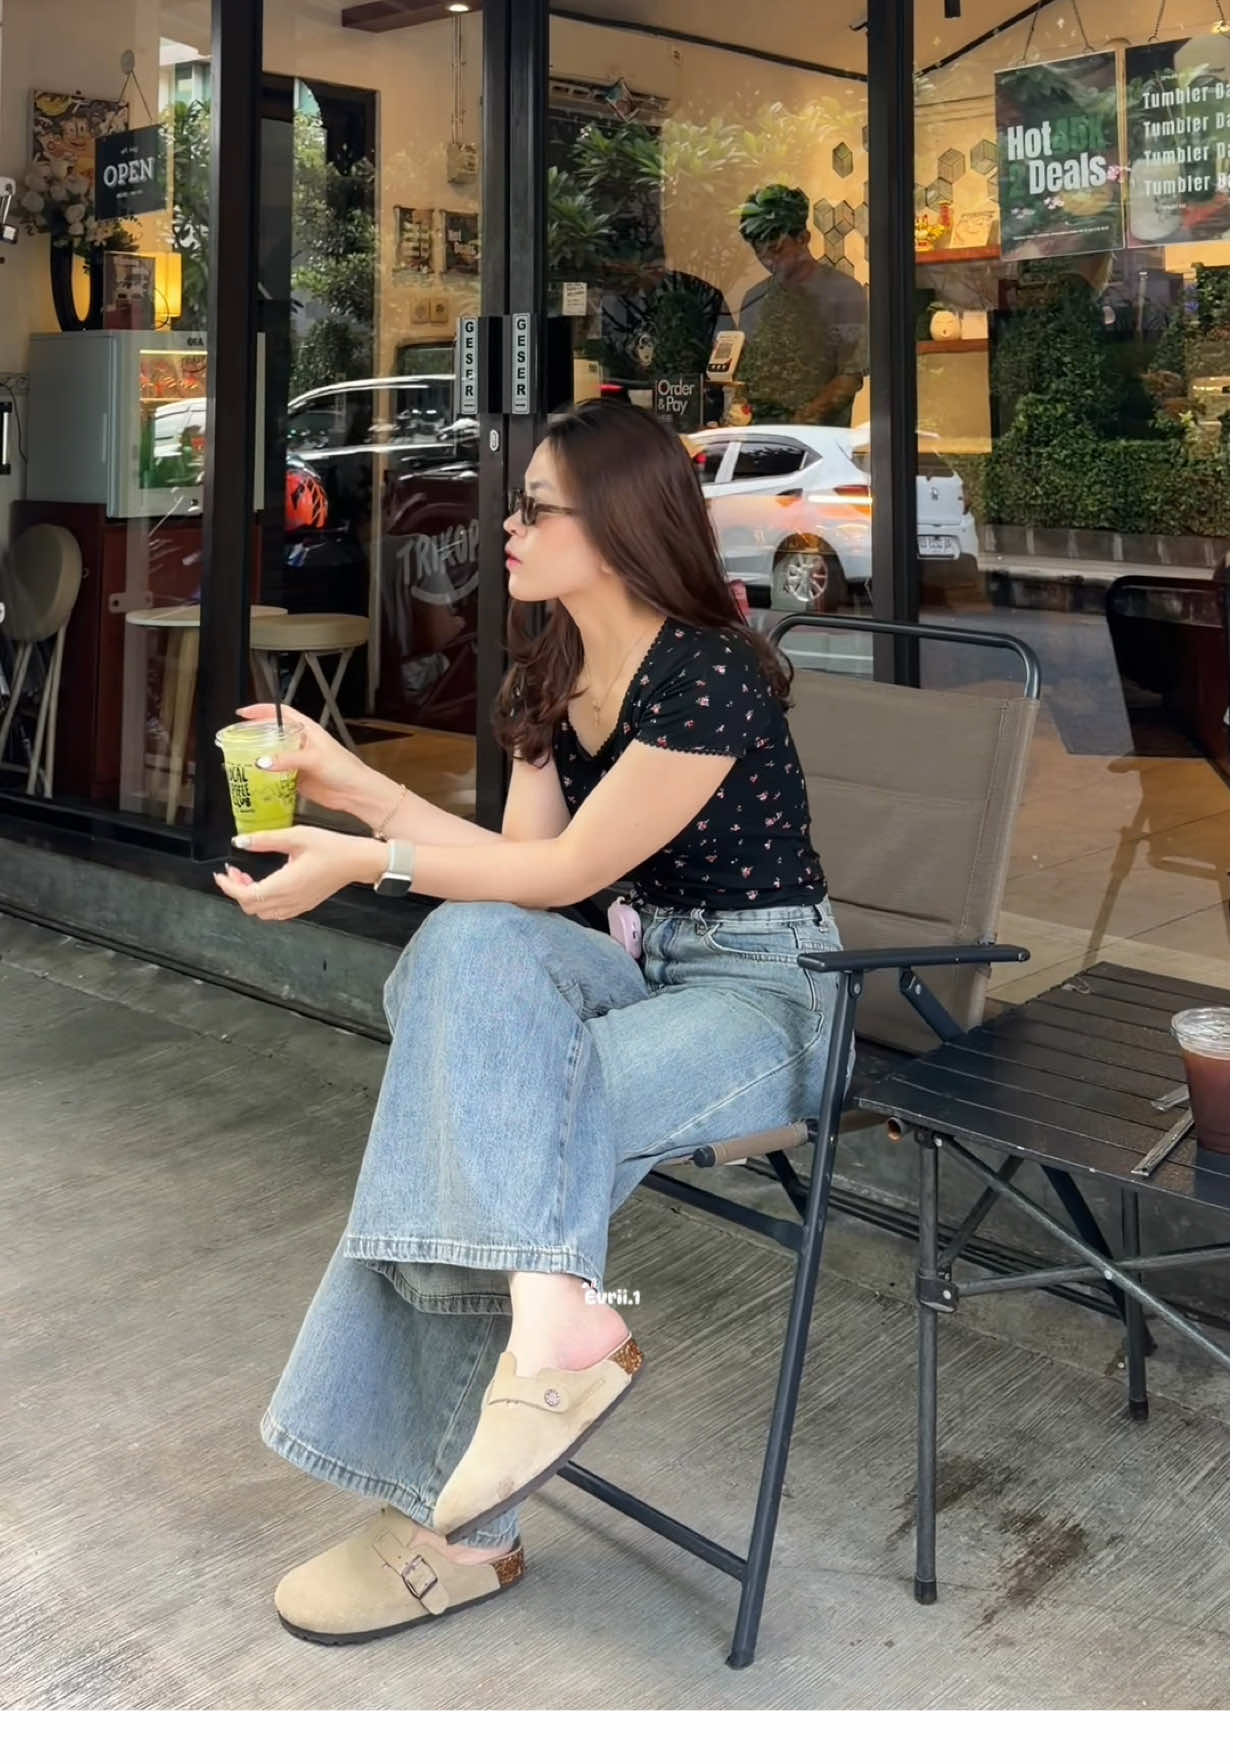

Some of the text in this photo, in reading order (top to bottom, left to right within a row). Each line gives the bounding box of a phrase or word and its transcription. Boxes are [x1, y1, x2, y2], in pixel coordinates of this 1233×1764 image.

[1142, 86, 1208, 109] Tumbler
[1143, 116, 1208, 139] Tumbler
[1007, 121, 1053, 161] Hot
[1143, 146, 1209, 168] Tumbler
[103, 156, 155, 187] OPEN
[1029, 152, 1106, 195] Deals
[1144, 175, 1210, 198] Tumbler
[464, 321, 475, 397] GESER
[516, 319, 527, 396] GESER
[657, 379, 695, 396] Order
[658, 396, 688, 416] & Pay
